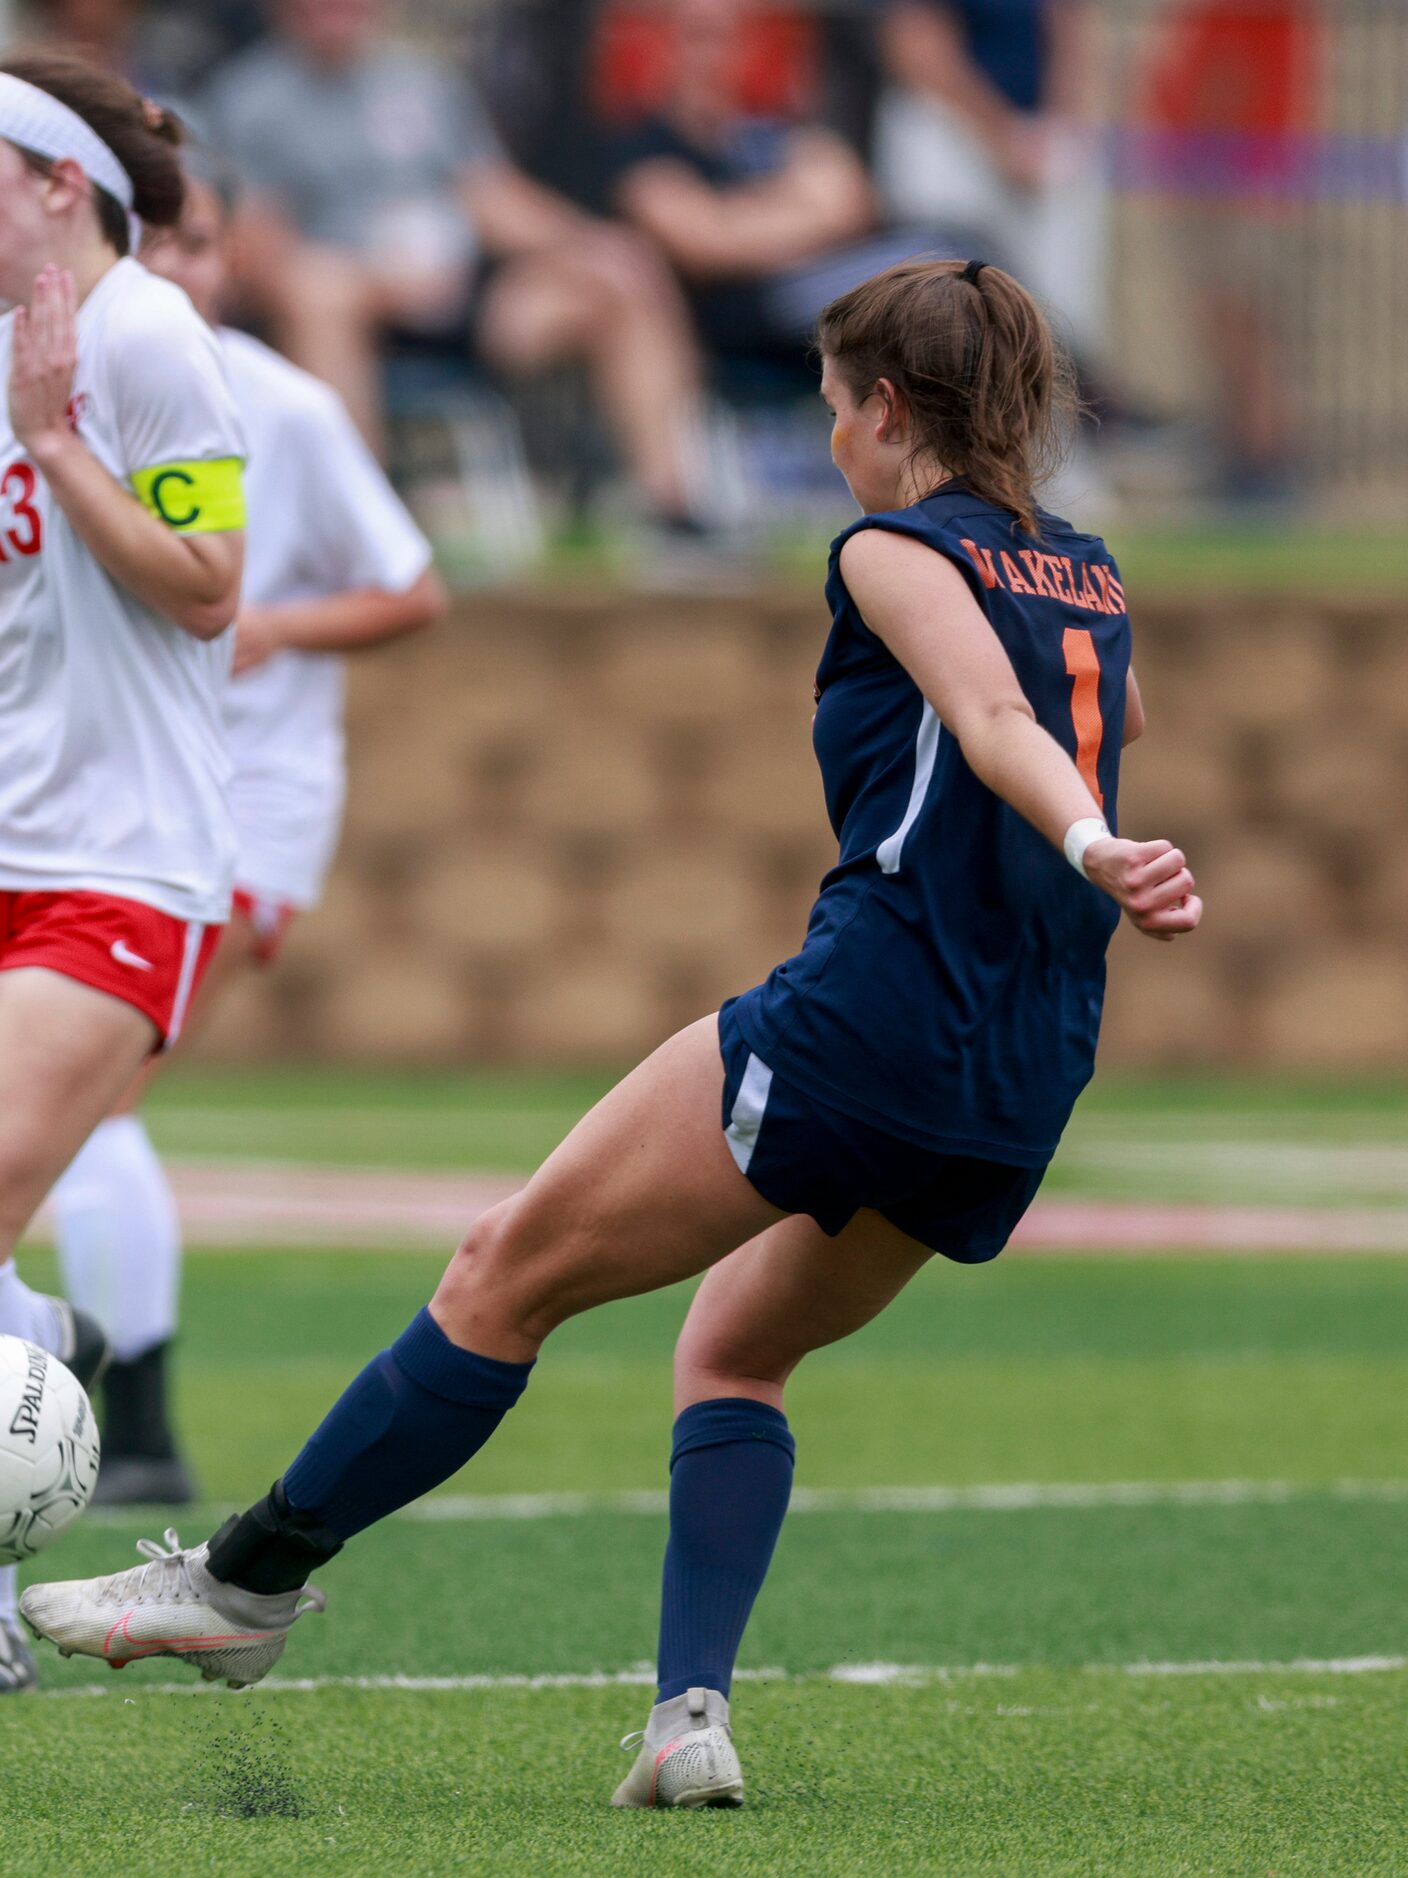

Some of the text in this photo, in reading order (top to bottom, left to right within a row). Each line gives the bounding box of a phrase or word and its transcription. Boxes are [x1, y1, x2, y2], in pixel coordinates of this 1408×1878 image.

[150, 470, 200, 526] C
[1061, 627, 1105, 813] 1
[9, 1342, 48, 1445] SPALDIN
